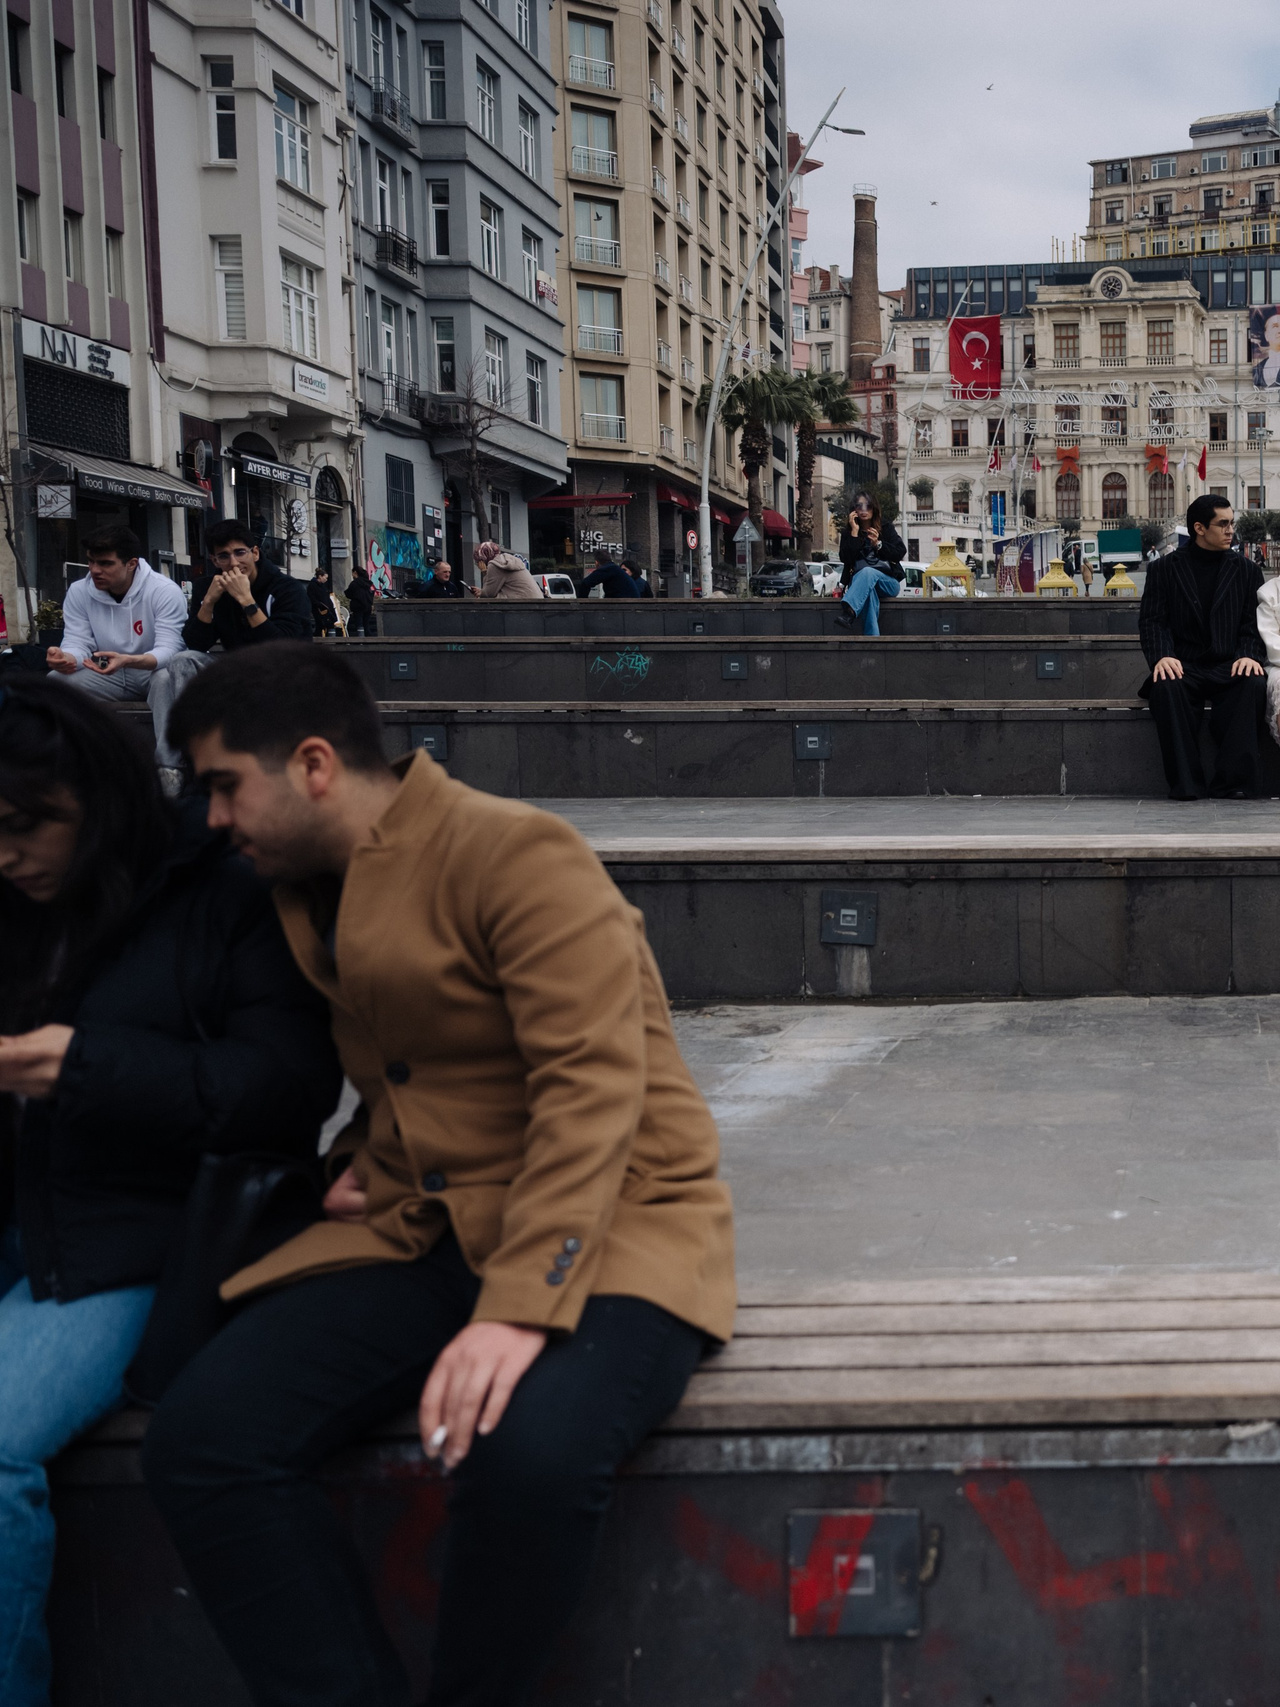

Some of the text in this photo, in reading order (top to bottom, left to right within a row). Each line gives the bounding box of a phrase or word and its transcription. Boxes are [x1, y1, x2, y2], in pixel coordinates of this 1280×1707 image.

[298, 370, 326, 390] brandworks
[247, 462, 271, 476] AYFER
[272, 468, 291, 481] CHEF
[84, 476, 103, 490] Food
[106, 480, 125, 493] Wine
[127, 484, 151, 499] Coffee
[154, 489, 171, 502] Bistro
[174, 494, 203, 508] Cocktails
